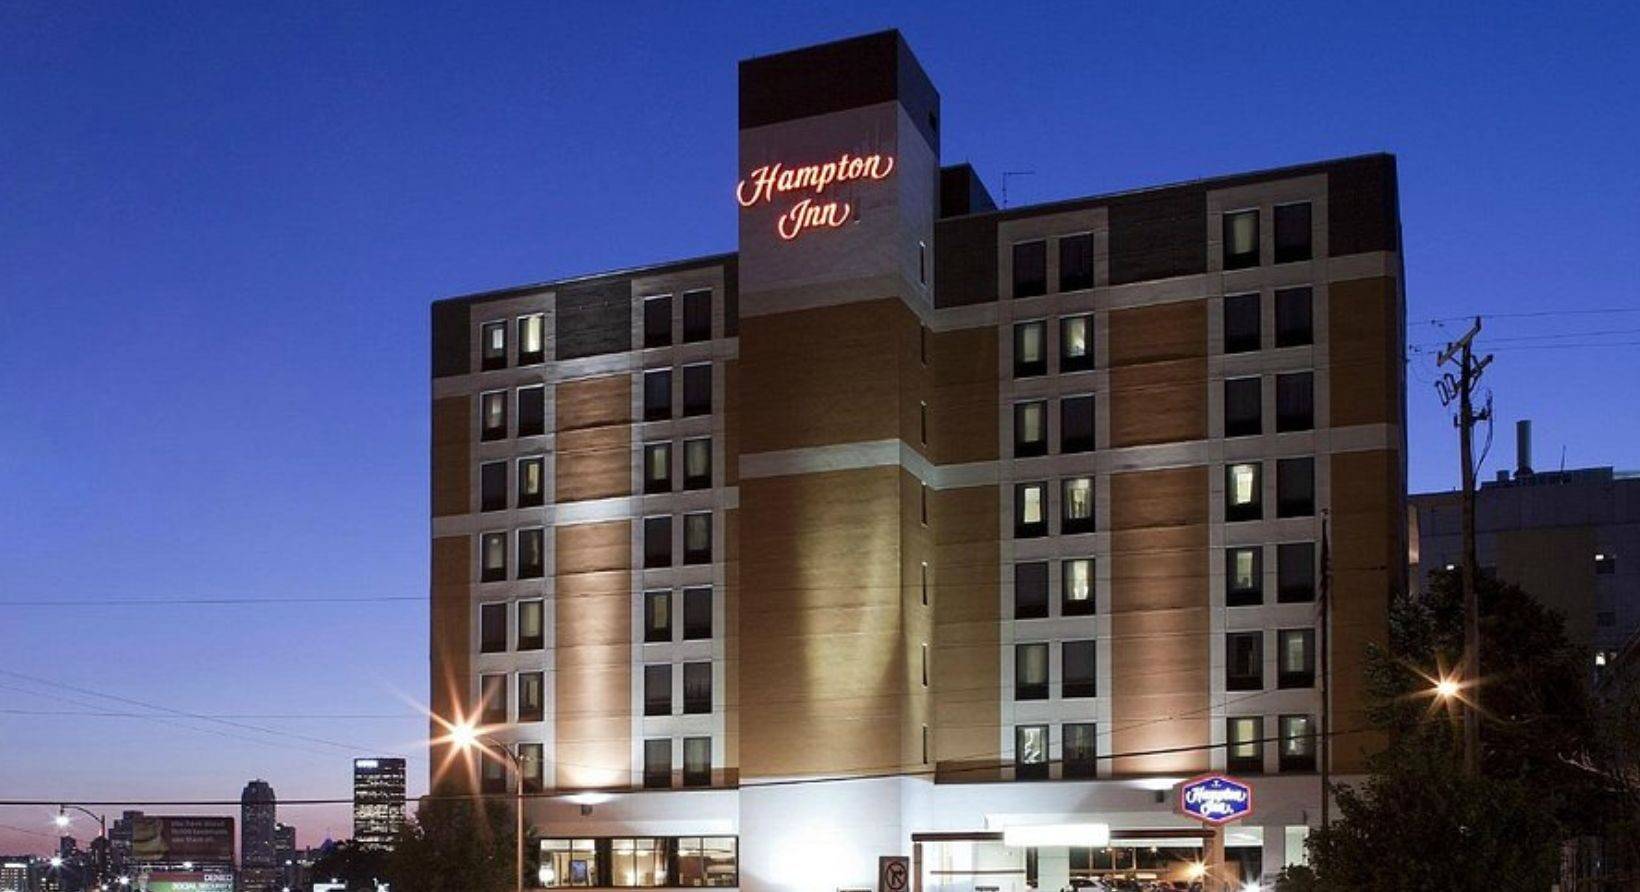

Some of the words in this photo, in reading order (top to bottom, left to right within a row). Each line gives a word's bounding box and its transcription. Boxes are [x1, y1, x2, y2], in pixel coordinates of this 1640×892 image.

[736, 154, 894, 206] Hampton
[778, 198, 850, 240] Inn
[1186, 786, 1247, 804] Hampton
